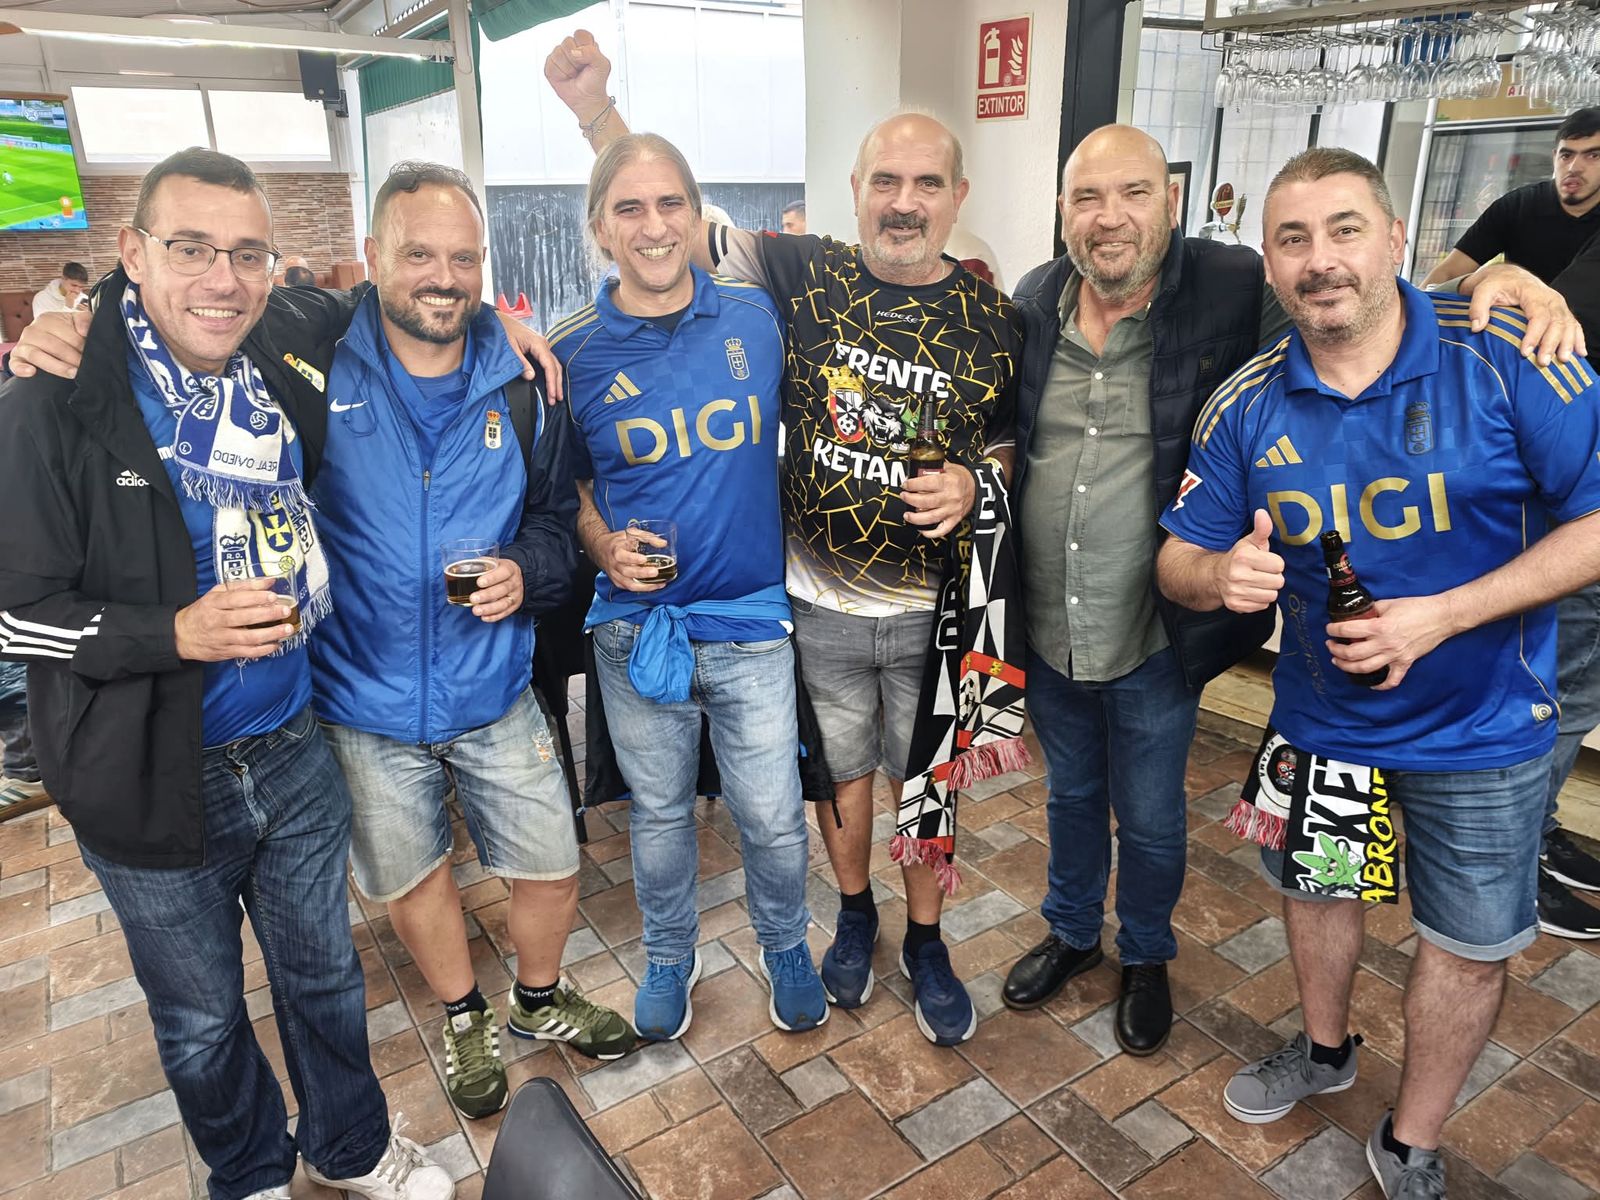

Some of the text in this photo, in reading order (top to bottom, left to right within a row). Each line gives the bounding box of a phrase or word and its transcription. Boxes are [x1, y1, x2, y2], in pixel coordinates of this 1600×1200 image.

[978, 95, 1024, 115] EXTINTOR
[835, 341, 951, 398] FRENTE
[615, 395, 761, 465] DIGI
[813, 437, 909, 487] KETAM
[1267, 473, 1451, 546] DIGI
[1303, 755, 1372, 845] KE
